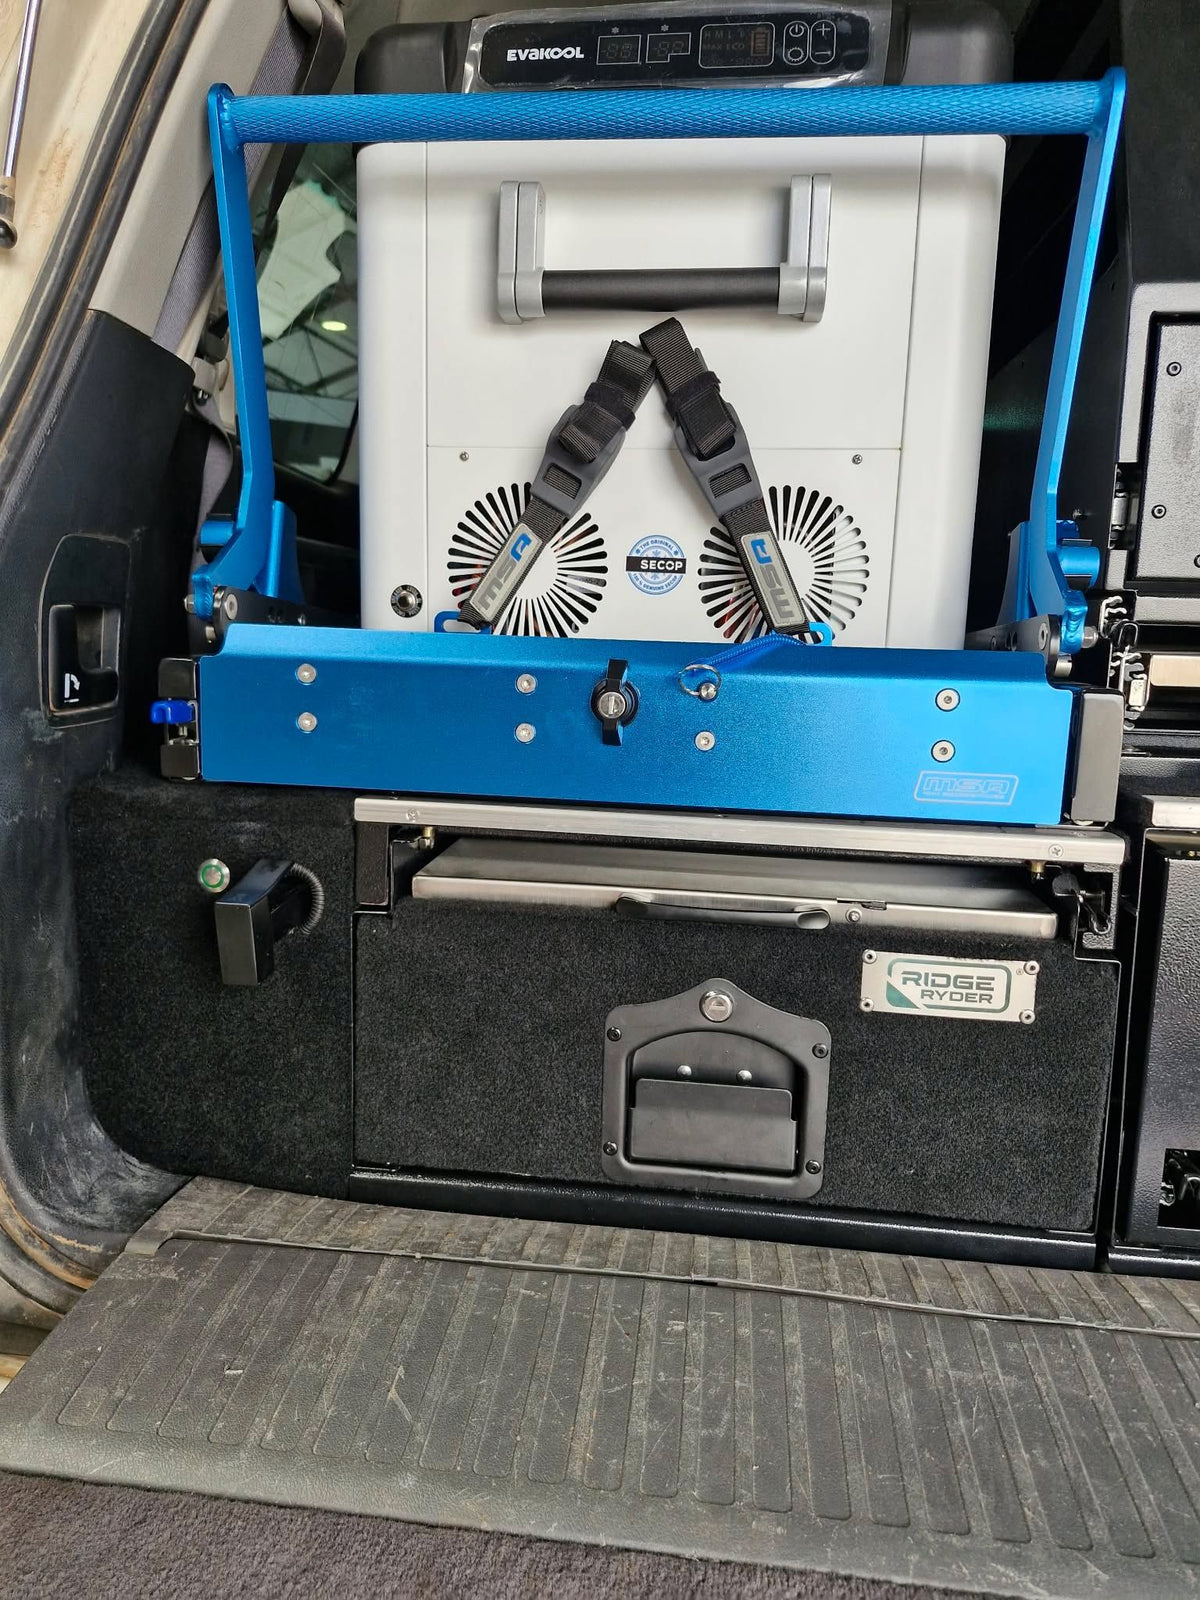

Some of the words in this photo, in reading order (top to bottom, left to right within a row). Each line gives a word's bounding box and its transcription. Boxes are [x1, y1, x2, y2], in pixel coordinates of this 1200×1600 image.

[640, 559, 683, 571] SECOP
[901, 970, 995, 992] RIDGE
[920, 989, 993, 1004] RYDER
